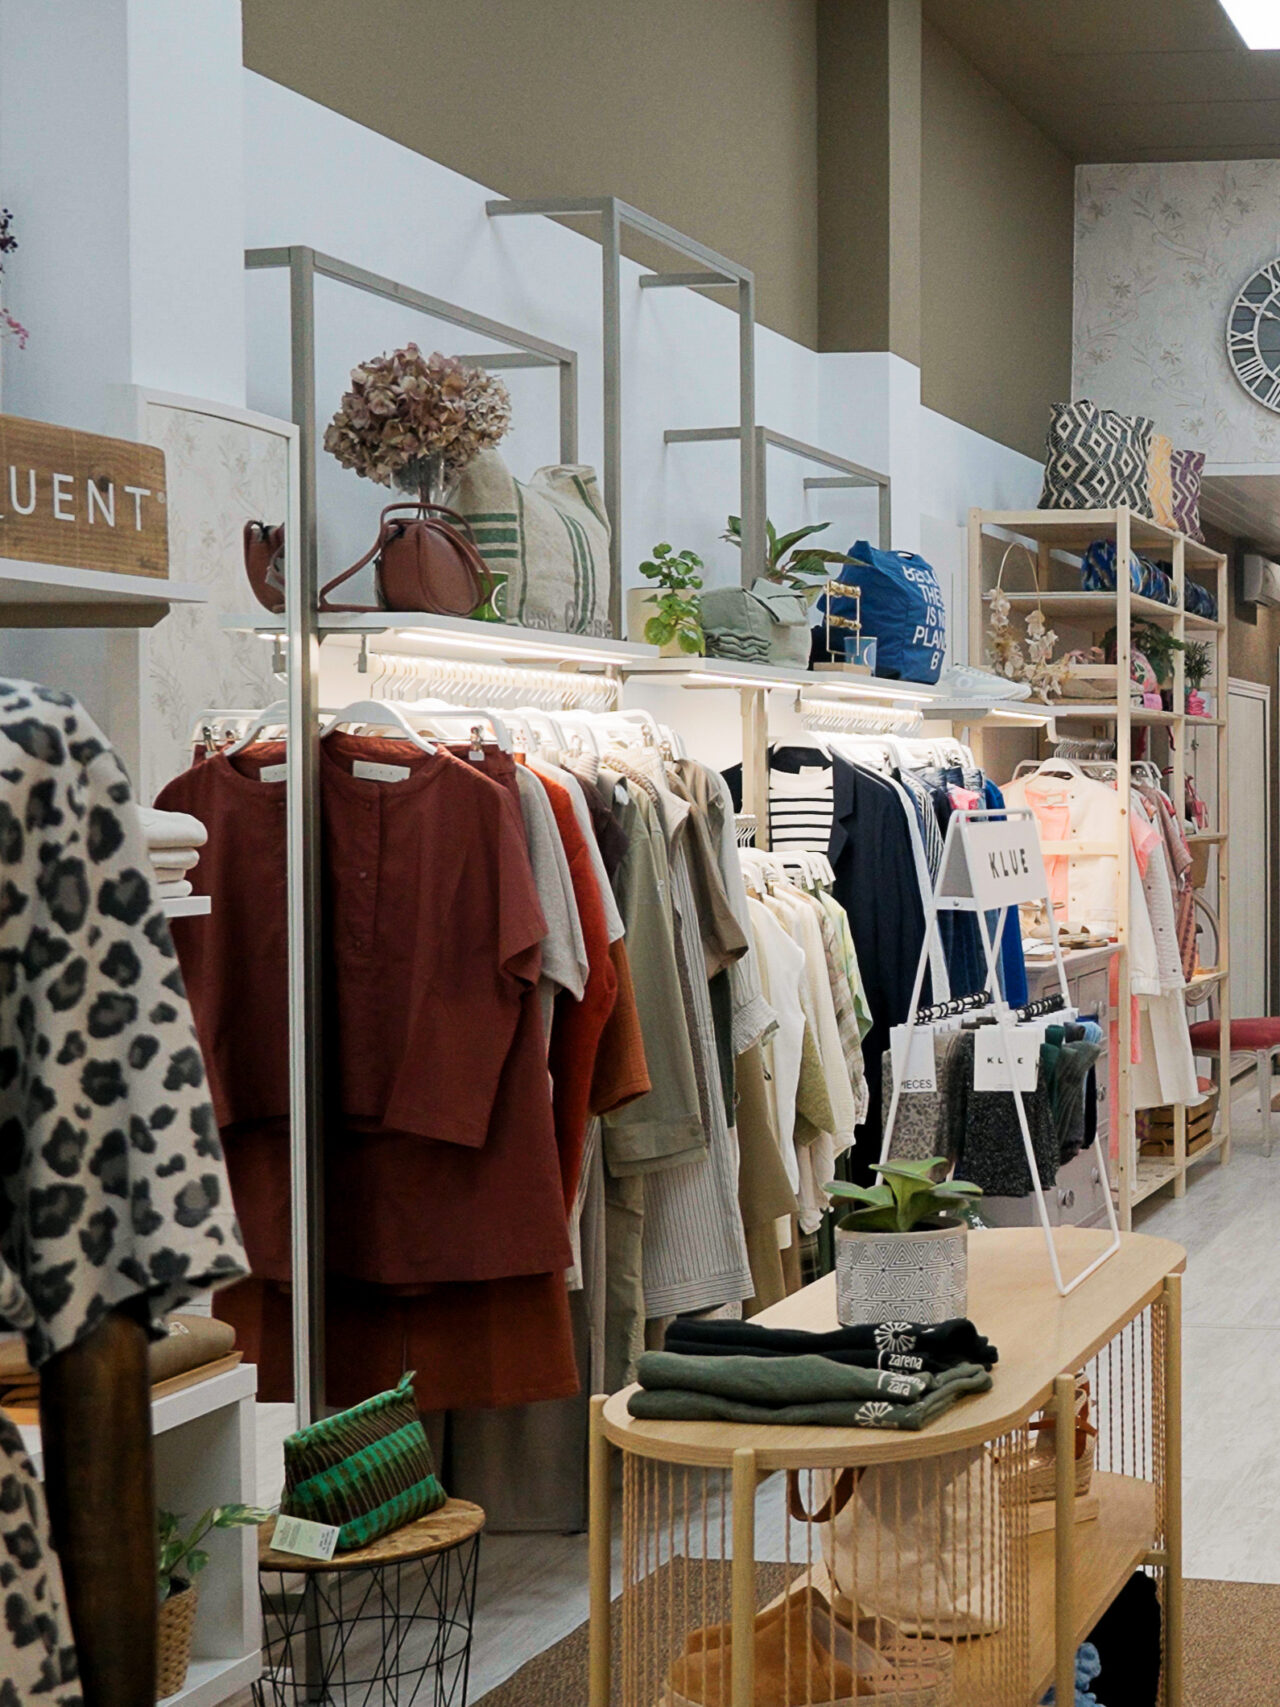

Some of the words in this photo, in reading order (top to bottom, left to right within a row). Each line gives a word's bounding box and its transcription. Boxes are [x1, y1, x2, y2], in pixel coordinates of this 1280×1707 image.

[0, 465, 151, 531] UENT
[918, 584, 944, 608] THE
[926, 606, 937, 627] IS
[930, 651, 941, 670] B
[989, 848, 1029, 879] KLUE
[987, 1057, 1024, 1065] KLE
[901, 1079, 933, 1090] IECES
[888, 1353, 923, 1371] zarena
[887, 1381, 910, 1396] zara
